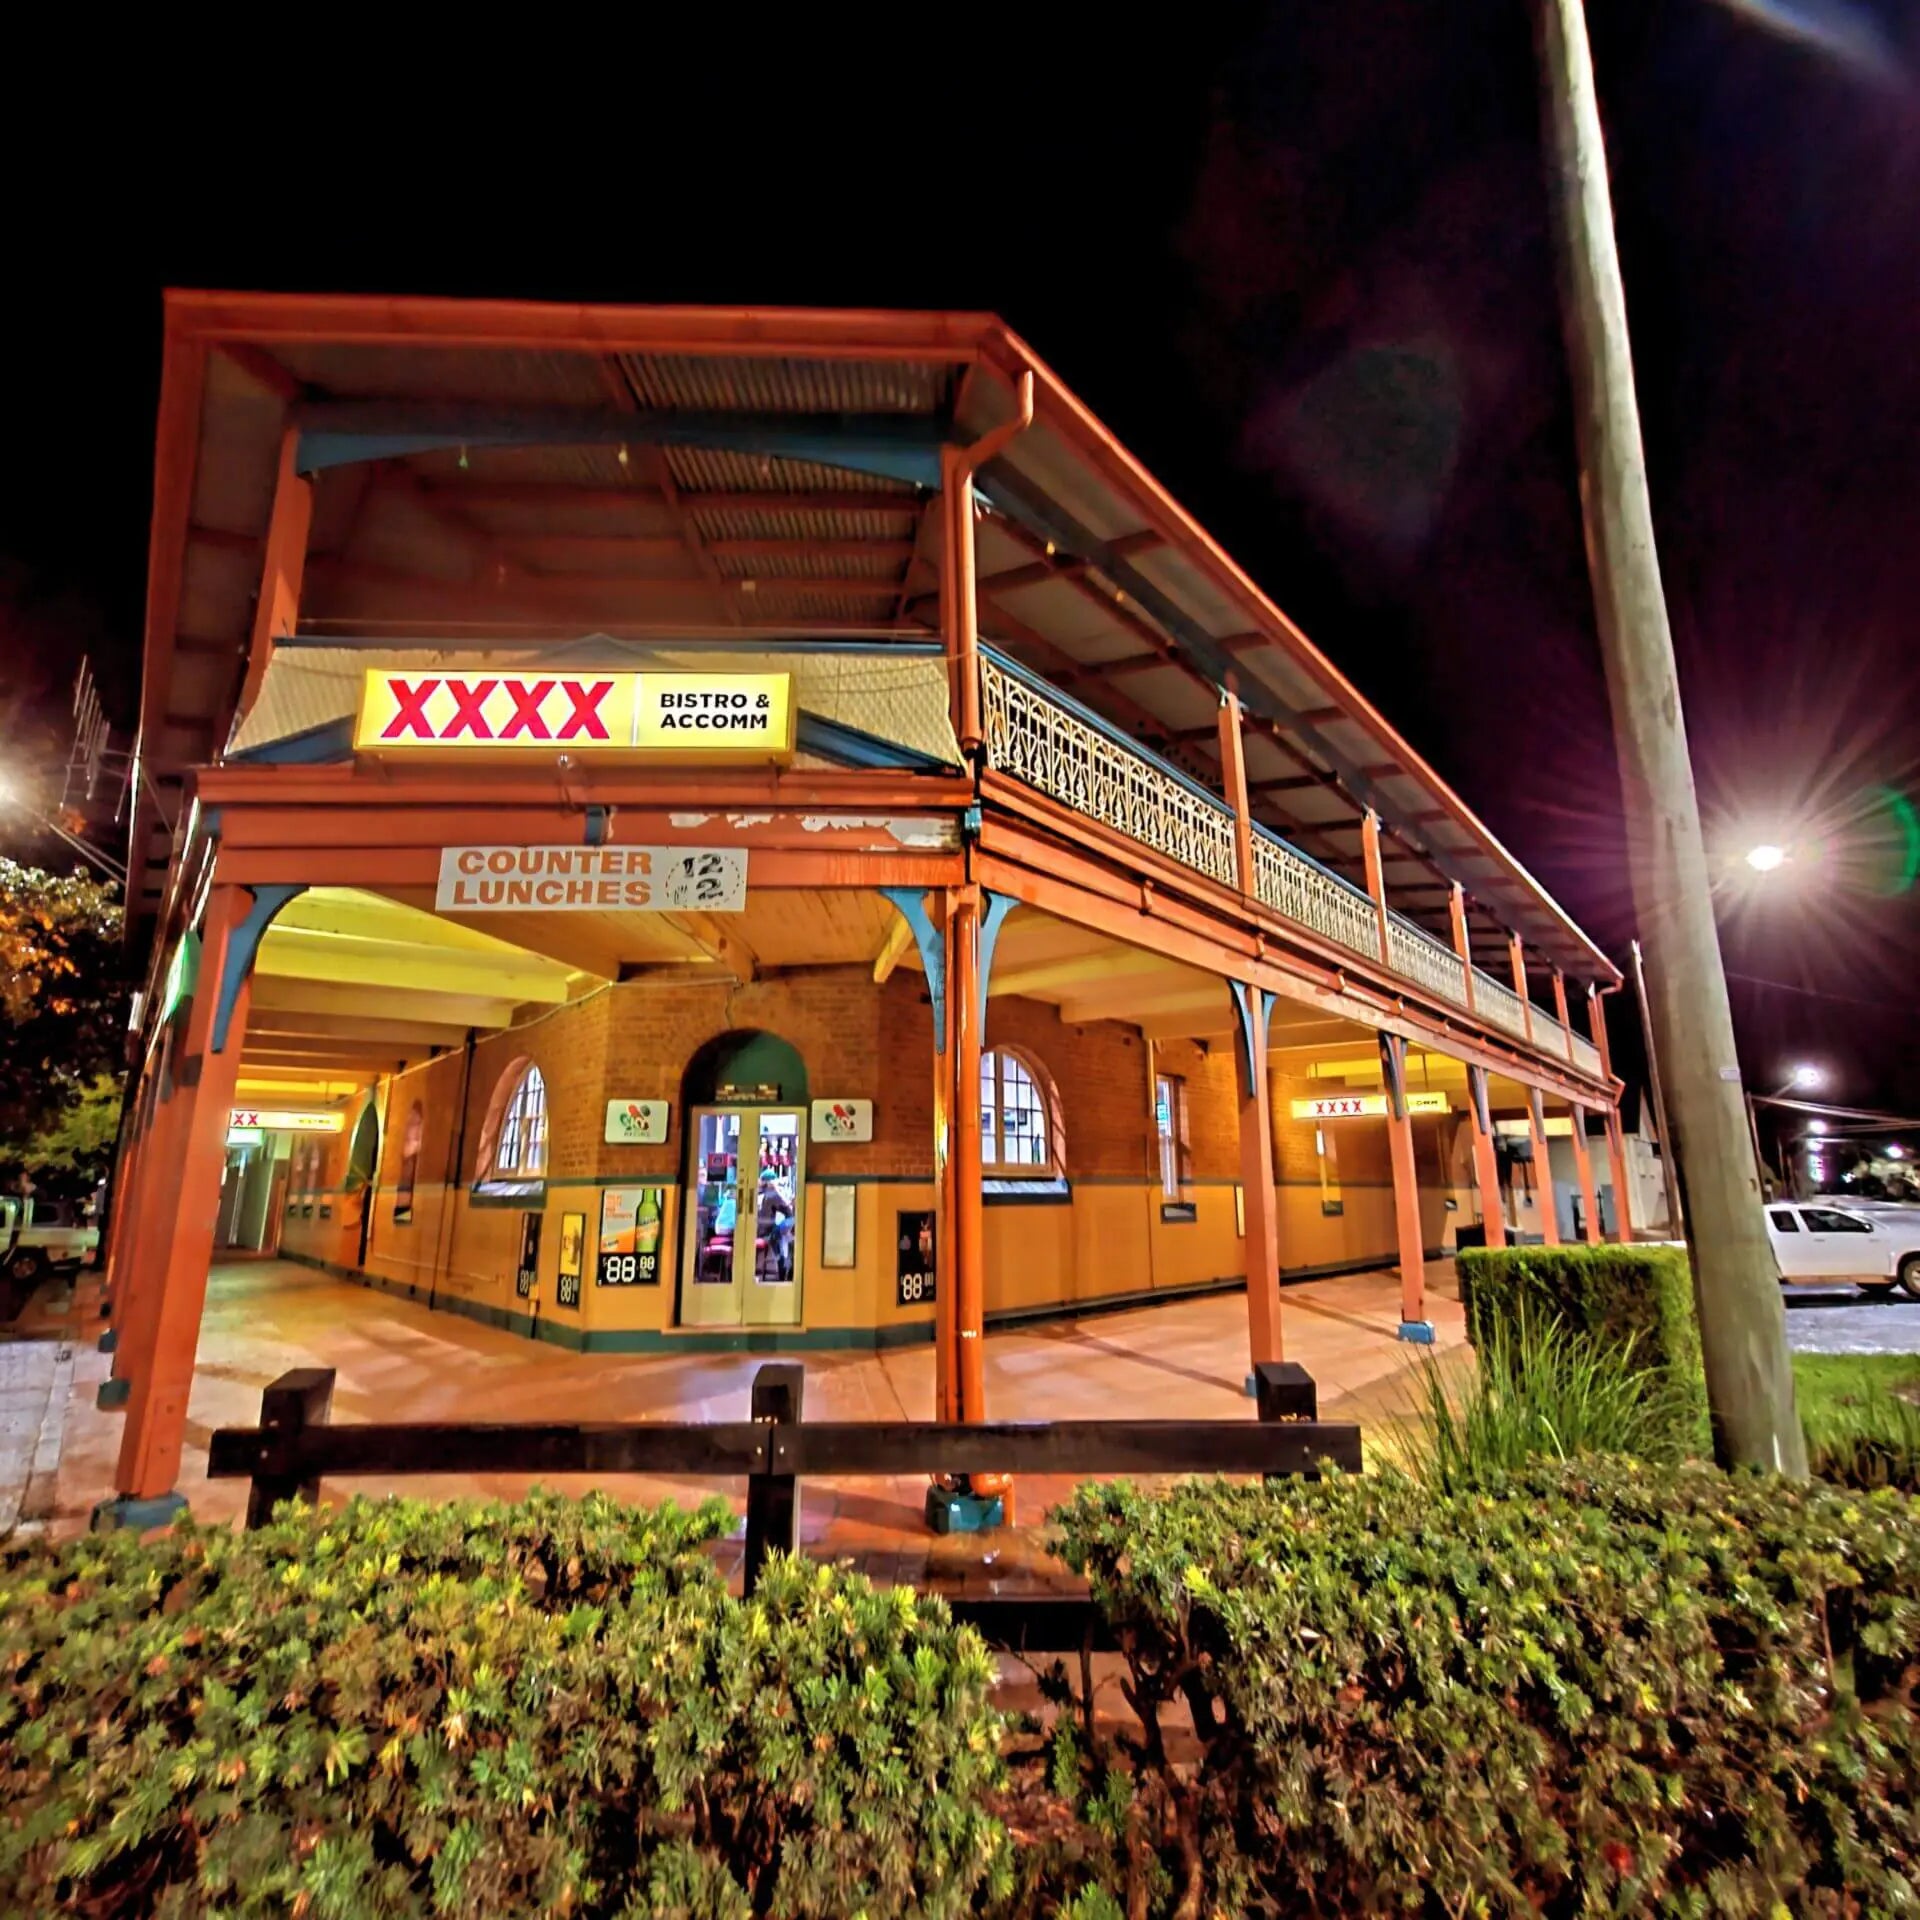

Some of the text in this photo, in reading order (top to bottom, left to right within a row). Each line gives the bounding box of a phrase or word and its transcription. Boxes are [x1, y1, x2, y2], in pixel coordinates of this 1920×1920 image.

[660, 693, 770, 708] BISTRO &
[380, 679, 615, 739] XXXX
[660, 713, 767, 729] ACCOMM
[457, 850, 653, 875] COUNTER
[452, 880, 653, 906] LUNCHES
[1316, 1100, 1362, 1115] XXXX
[233, 1112, 258, 1126] XX
